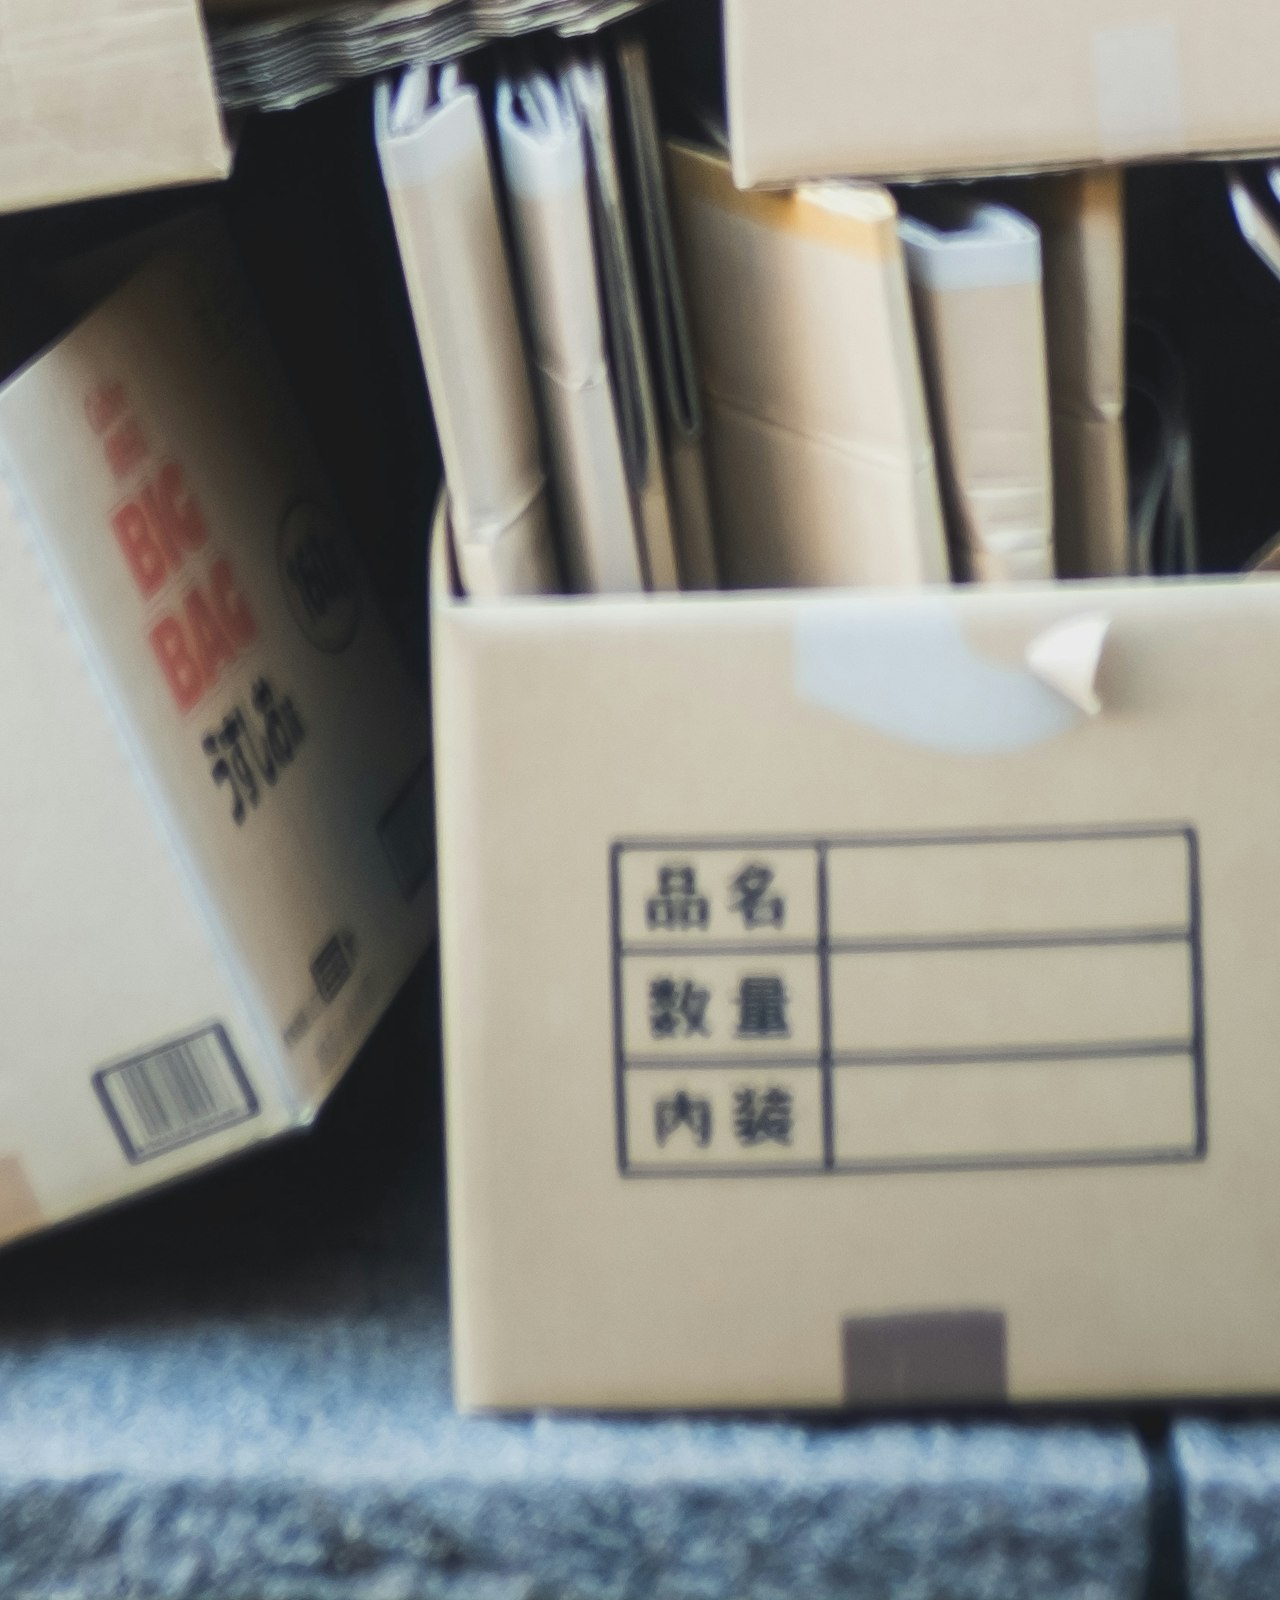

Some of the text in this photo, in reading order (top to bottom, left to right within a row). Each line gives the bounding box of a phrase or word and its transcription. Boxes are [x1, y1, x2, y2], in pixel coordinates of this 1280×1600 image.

[109, 460, 211, 599] BIG
[146, 556, 261, 714] BAG
[645, 862, 787, 932] 品名
[647, 975, 792, 1042] 数量
[654, 1084, 796, 1150] 内装
